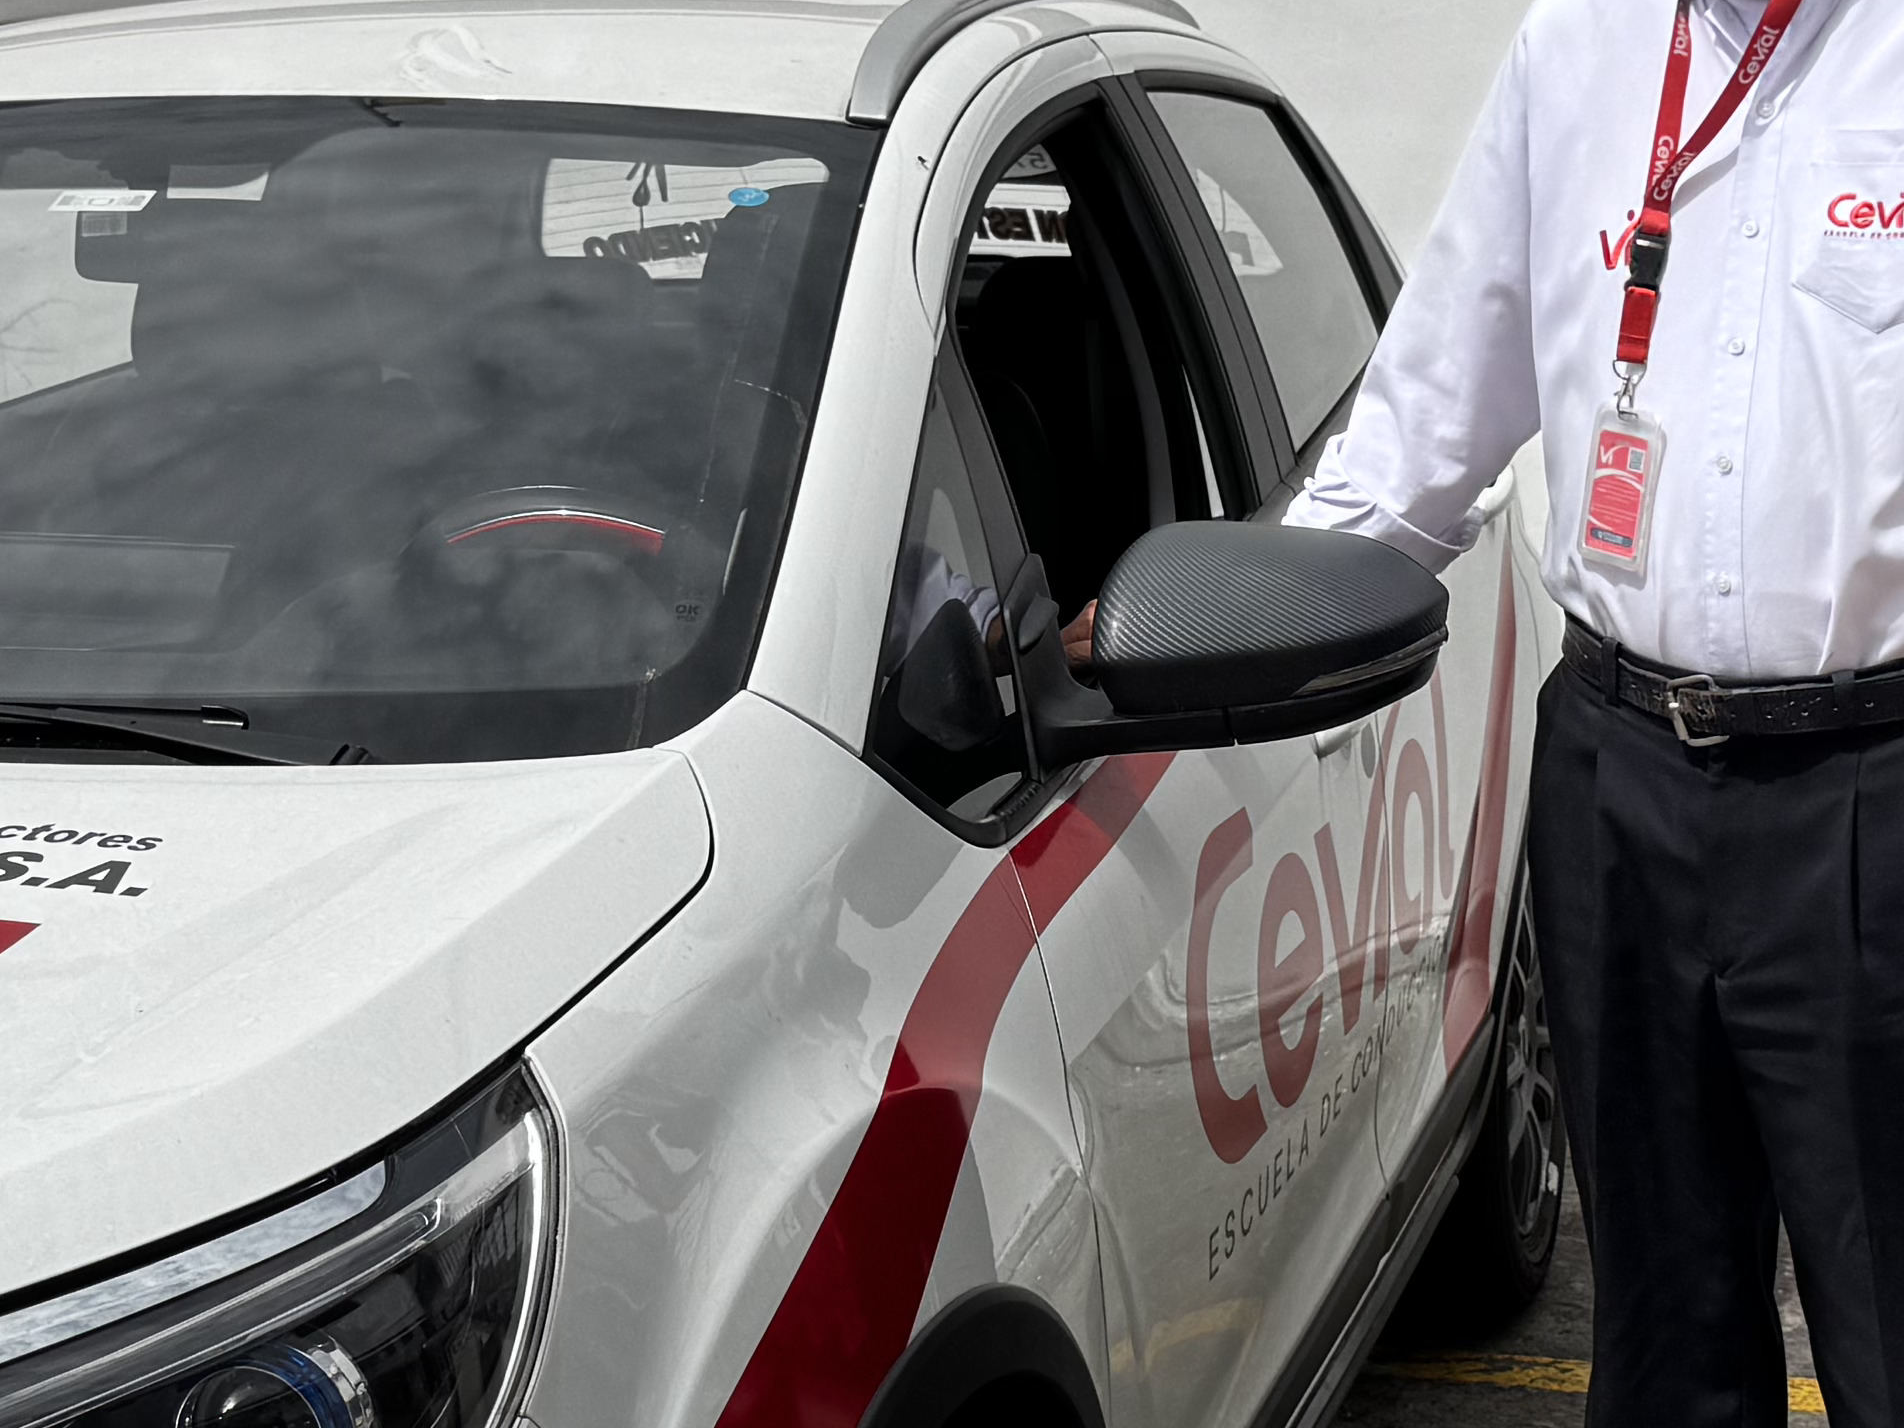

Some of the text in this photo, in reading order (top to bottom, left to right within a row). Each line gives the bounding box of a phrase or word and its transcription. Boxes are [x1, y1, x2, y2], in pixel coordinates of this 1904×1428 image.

[1738, 26, 1780, 84] Cevial
[1653, 151, 1696, 201] Cevial
[1186, 665, 1454, 1164] Cevial
[1208, 1118, 1310, 1282] ESCUELA
[1319, 1074, 1344, 1138] DE
